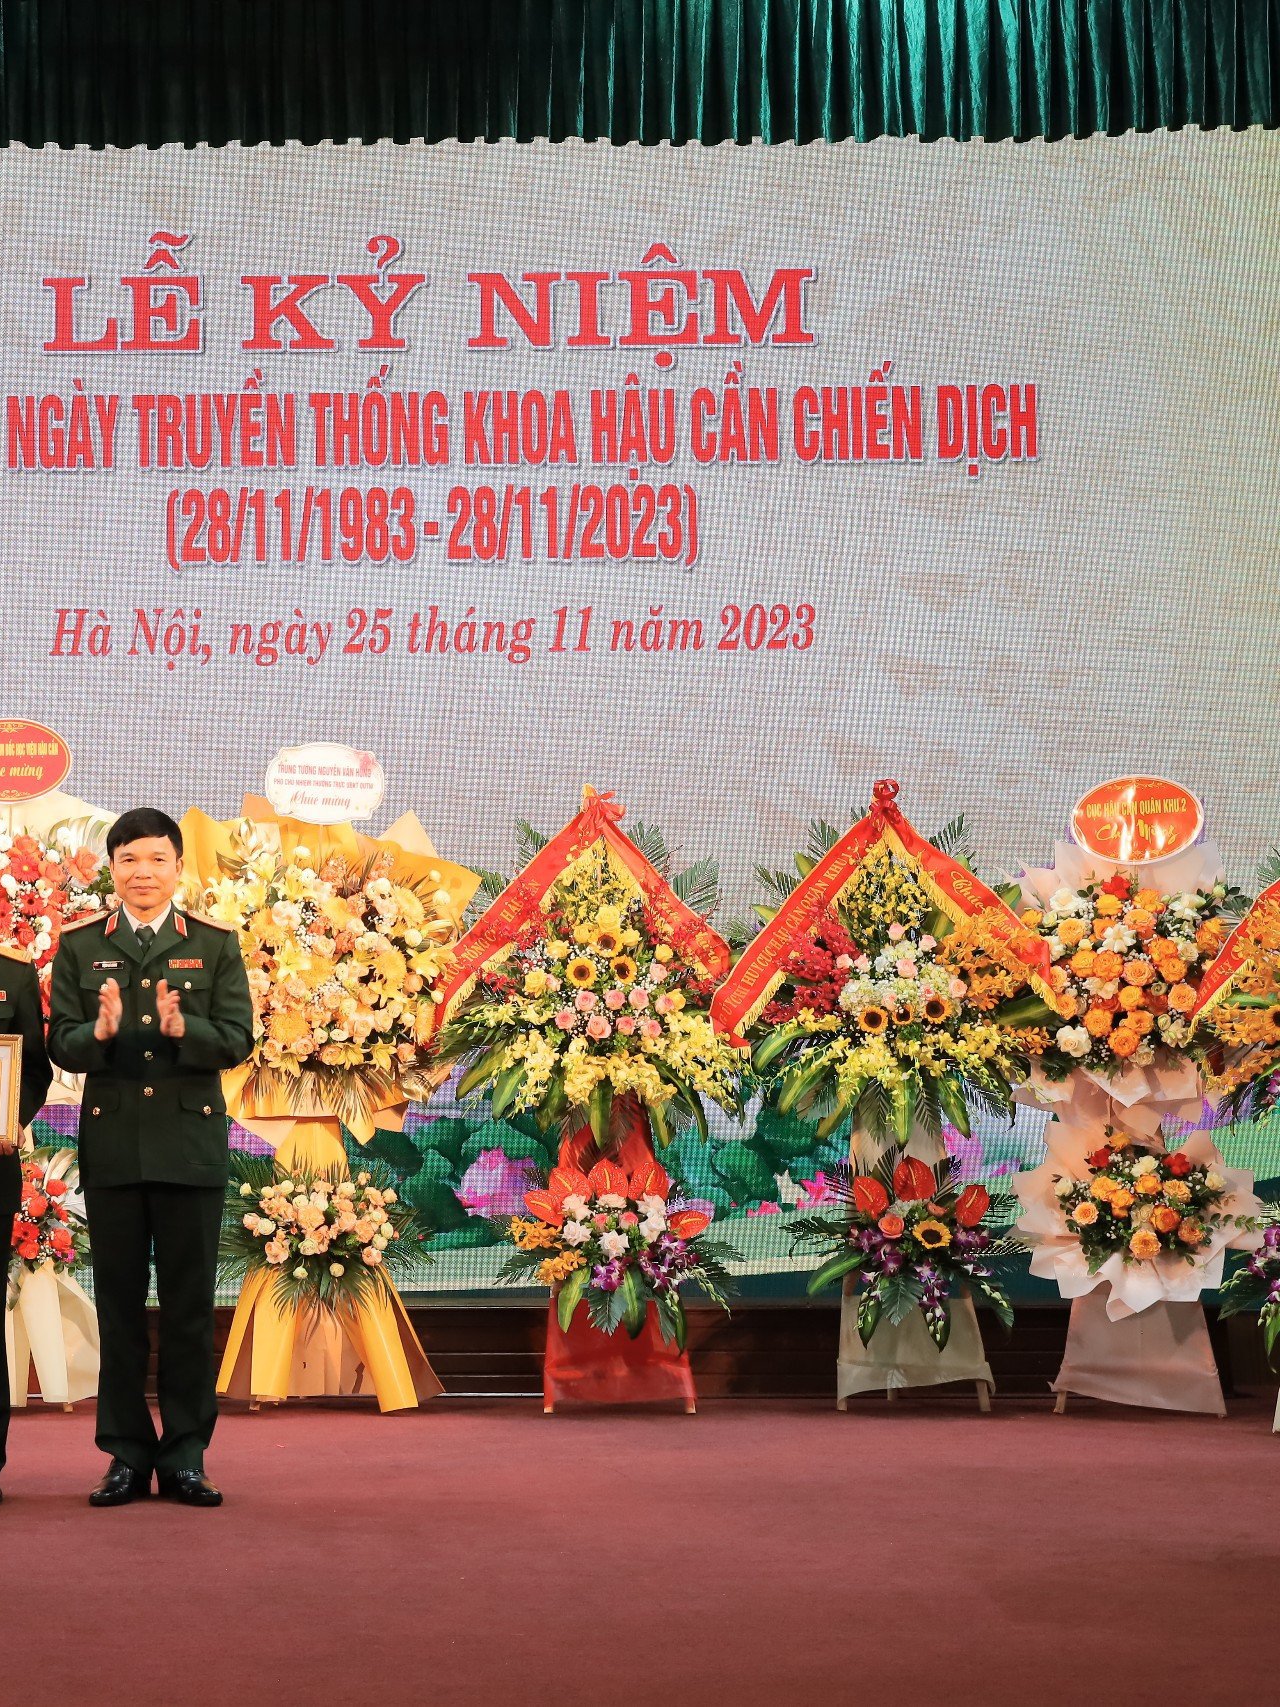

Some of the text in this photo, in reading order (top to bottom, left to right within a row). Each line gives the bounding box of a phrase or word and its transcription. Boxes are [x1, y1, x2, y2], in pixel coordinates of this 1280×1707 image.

[42, 231, 815, 370] LỄ KỶ NIỆM
[7, 379, 120, 470] NGÀY
[132, 368, 296, 469] TRUYỀN
[309, 364, 449, 467] THỐNG
[463, 389, 578, 465] KHOA
[590, 372, 676, 481] HẬU
[690, 361, 779, 464] CẦN
[793, 360, 923, 462] CHIẾN
[936, 383, 1038, 477] DỊCH
[50, 603, 816, 671] Hà Nội, ngày 25 tháng 11 năm 2023
[9, 763, 44, 781] mừng
[1139, 797, 1162, 816] QUÂN
[1163, 798, 1180, 814] KHU
[1180, 797, 1188, 812] 2
[822, 856, 847, 883] KHU
[950, 870, 986, 913] Chúc
